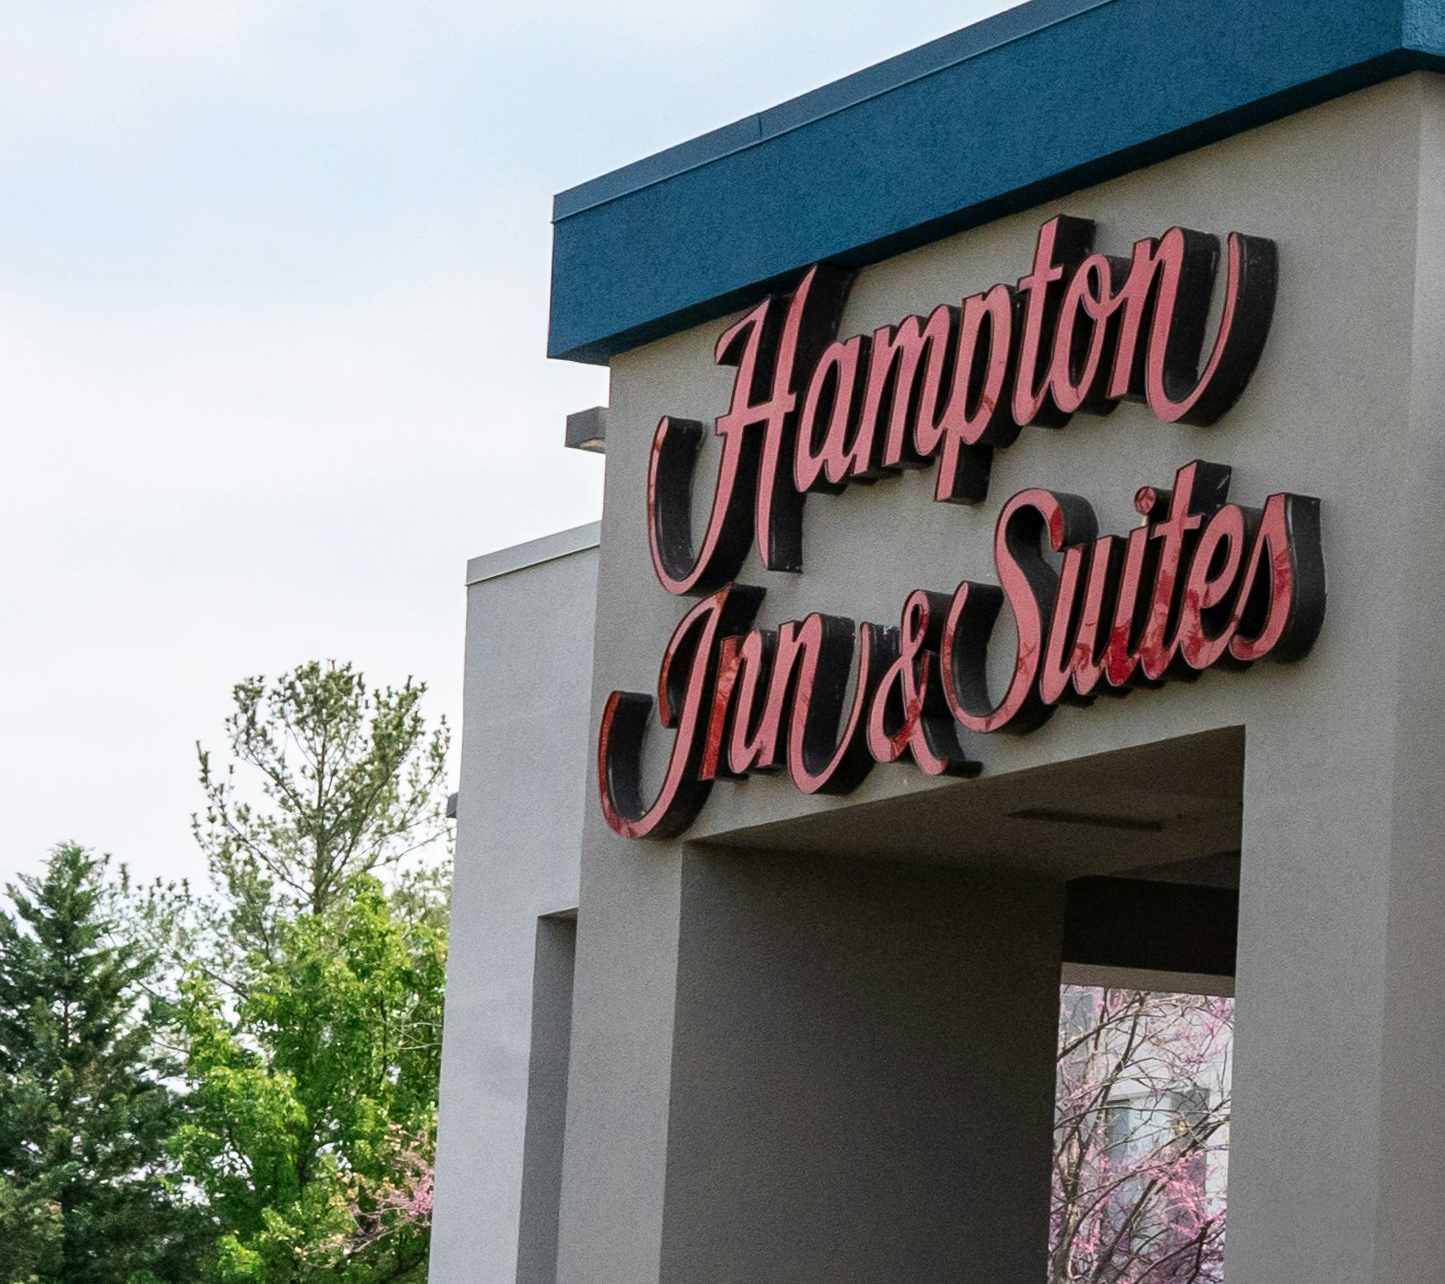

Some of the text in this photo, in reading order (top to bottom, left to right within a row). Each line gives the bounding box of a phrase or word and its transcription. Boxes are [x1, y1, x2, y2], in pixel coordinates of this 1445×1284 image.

[648, 214, 1280, 596] Hampton
[600, 460, 1326, 839] Inn & Suites
